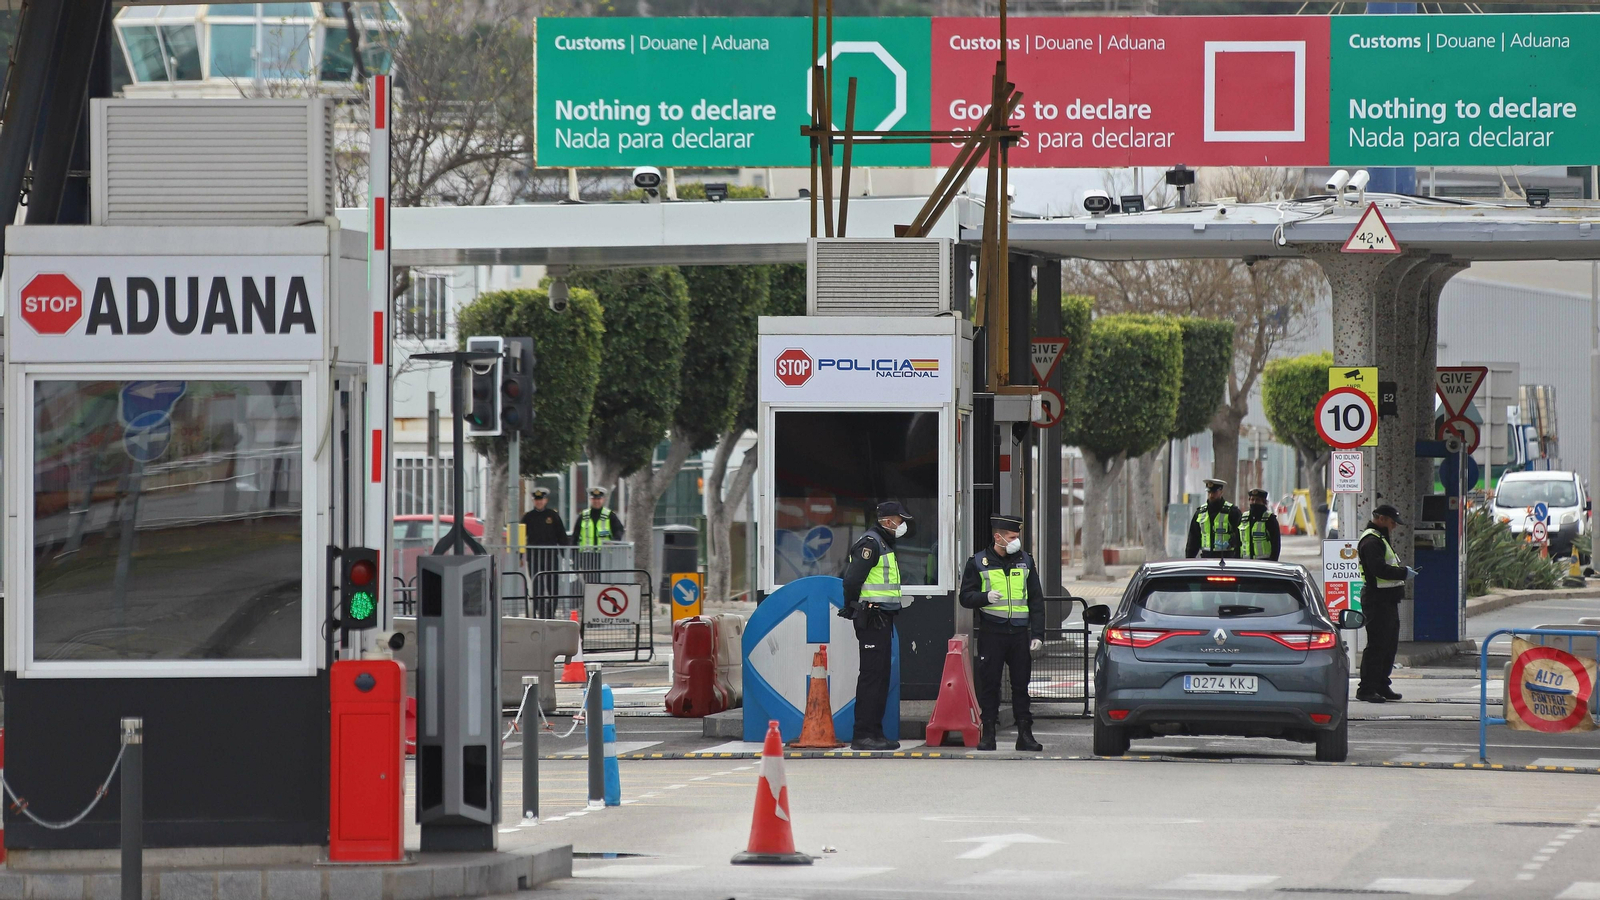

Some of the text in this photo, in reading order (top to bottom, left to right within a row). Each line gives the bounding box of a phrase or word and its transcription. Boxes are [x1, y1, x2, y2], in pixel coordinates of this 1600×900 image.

[554, 35, 769, 51] Customs Douane Aduana
[1035, 35, 1094, 50] Douane
[1107, 35, 1165, 50] Aduana
[1349, 32, 1570, 49] Customs Douane Aduana
[555, 98, 776, 126] Nothing to declare
[949, 97, 1152, 120] Gos to declare
[1349, 97, 1577, 124] Nothing to declare
[554, 128, 755, 154] Nada para declarar
[1038, 132, 1083, 153] para
[1091, 126, 1175, 148] declarar
[1349, 125, 1554, 152] Nada para declarar
[25, 296, 78, 313] STOP
[85, 276, 317, 336] ADUANA
[778, 359, 811, 376] STOP
[1034, 356, 1054, 364] WAY
[1440, 372, 1473, 384] GIVE
[1383, 393, 1394, 402] E2
[1445, 385, 1470, 394] WAY
[1327, 403, 1365, 432] 10
[1325, 562, 1359, 571] CUSTO
[1192, 677, 1225, 690] 0274
[1229, 677, 1255, 690] KKJ
[1535, 669, 1563, 686] ALTO
